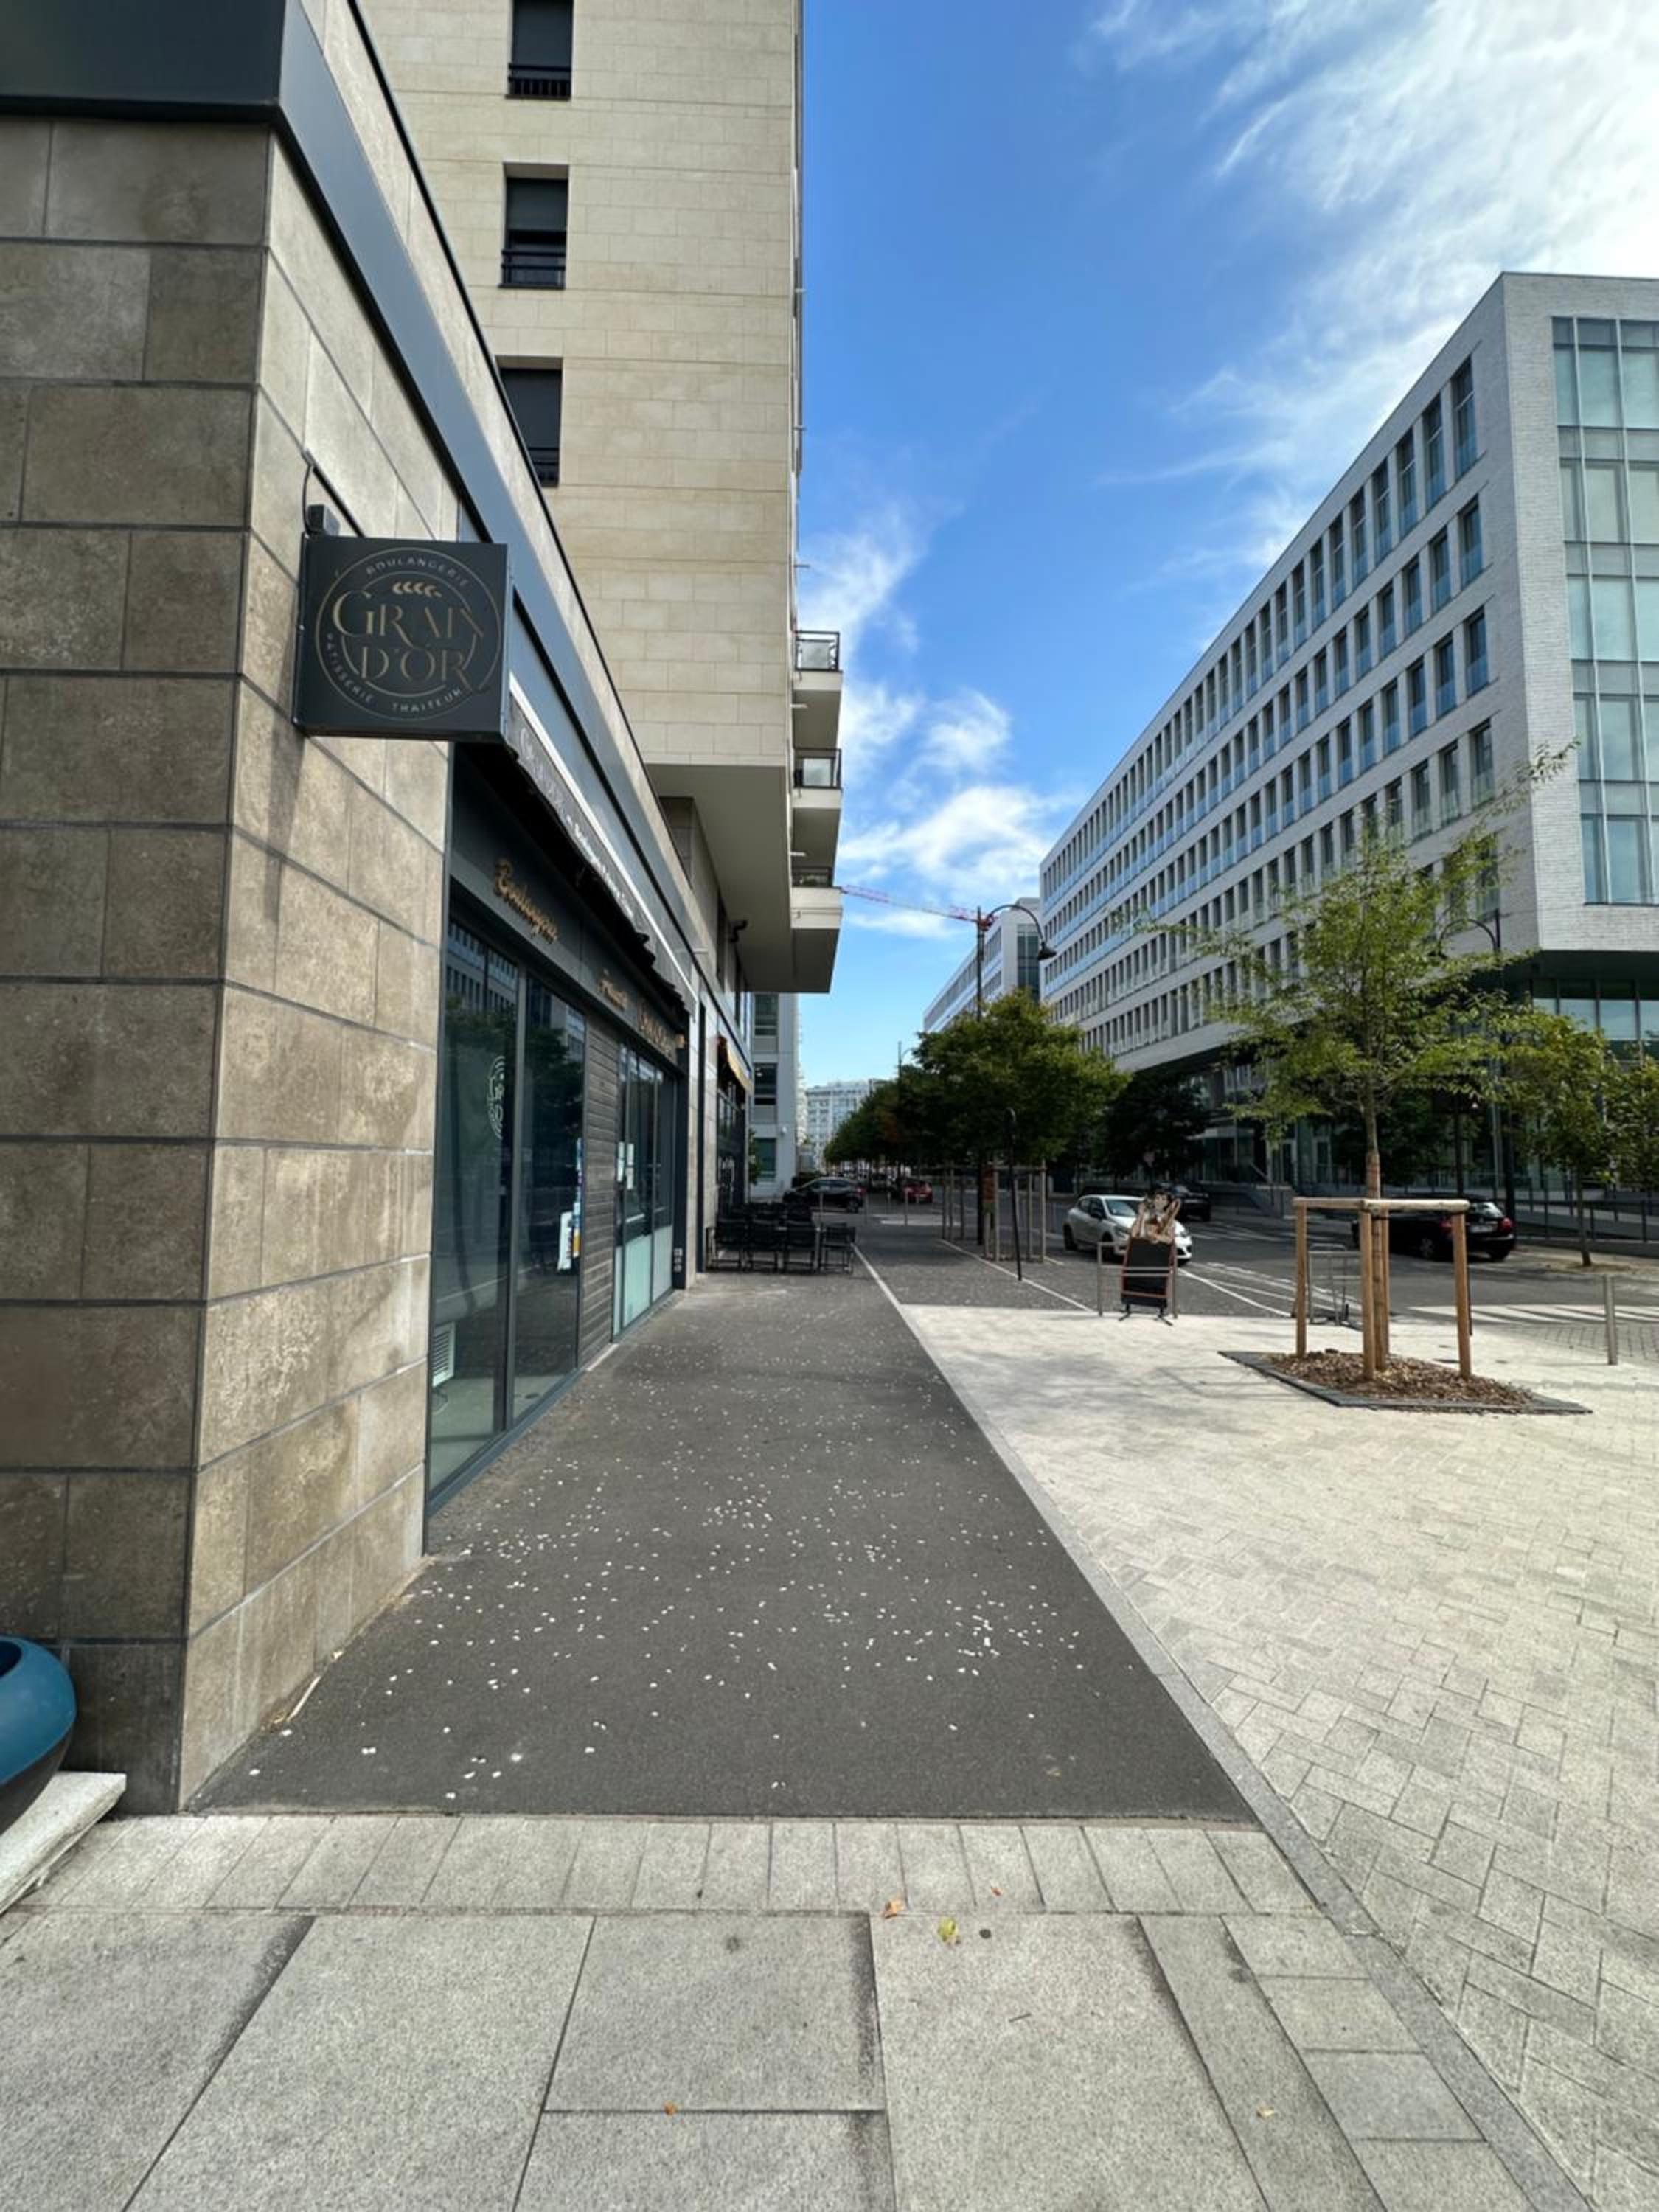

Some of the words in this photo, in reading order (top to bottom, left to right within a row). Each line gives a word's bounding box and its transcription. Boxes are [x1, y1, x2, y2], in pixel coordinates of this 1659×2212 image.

[366, 557, 469, 587] BOULANGERIE
[333, 588, 484, 648] GRAIN
[360, 646, 475, 692] D'OR
[392, 687, 461, 713] TRAITEUR
